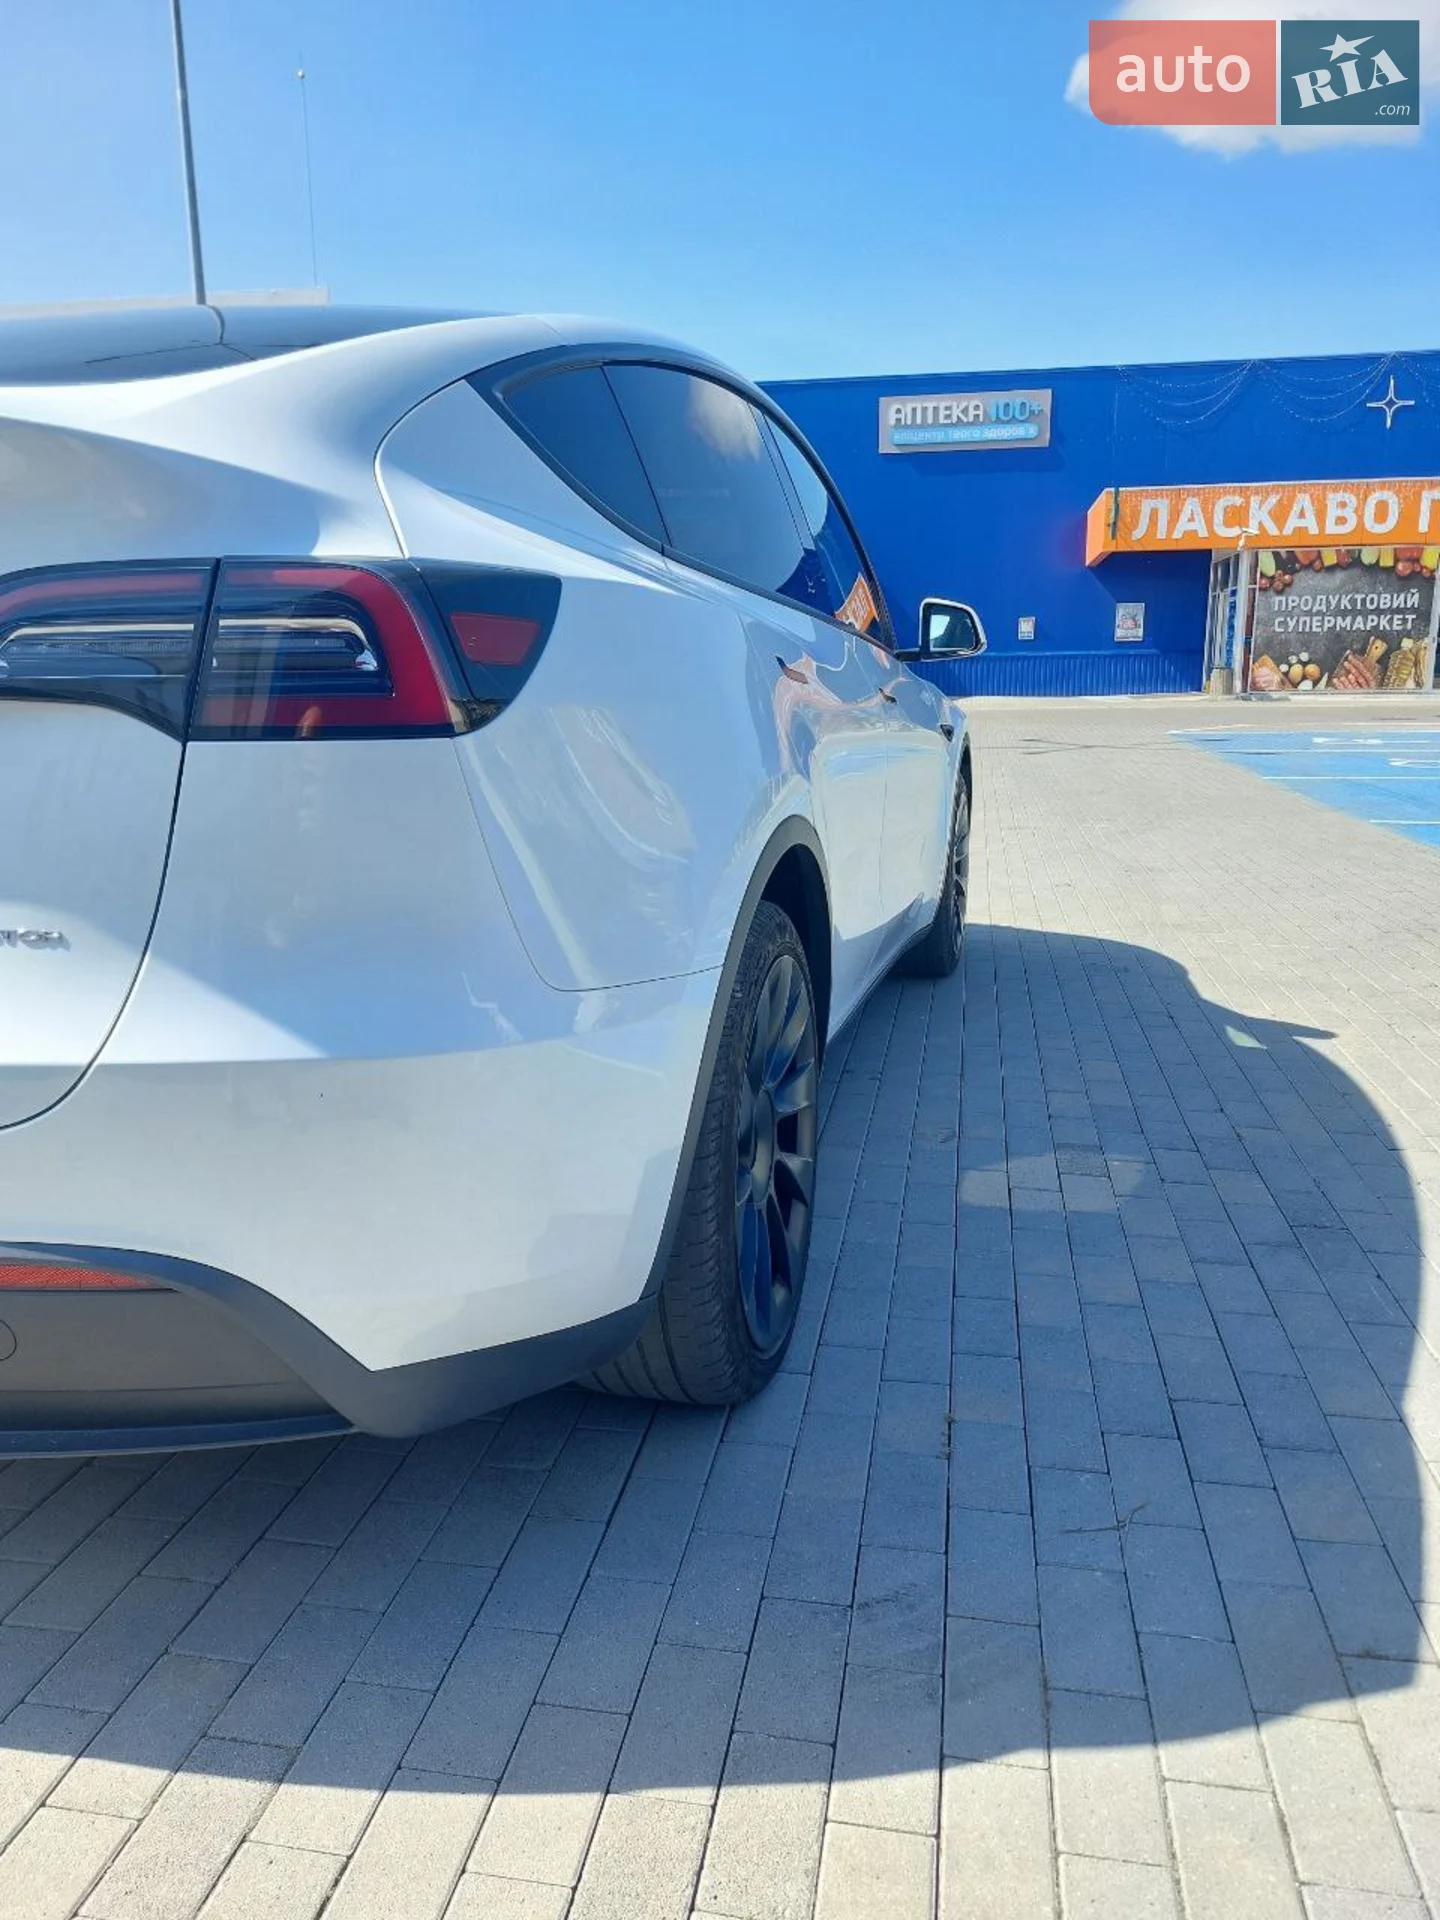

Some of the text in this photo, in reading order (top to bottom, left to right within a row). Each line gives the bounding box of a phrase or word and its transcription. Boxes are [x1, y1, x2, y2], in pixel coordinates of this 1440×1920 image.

[889, 399, 1044, 425] АПТЕКА 100+
[1131, 490, 1399, 541] ЛАСКАВО
[1272, 588, 1420, 615] ПРОДУКТОВИЙ
[1273, 614, 1417, 634] СУПЕРМАРКЕТ
